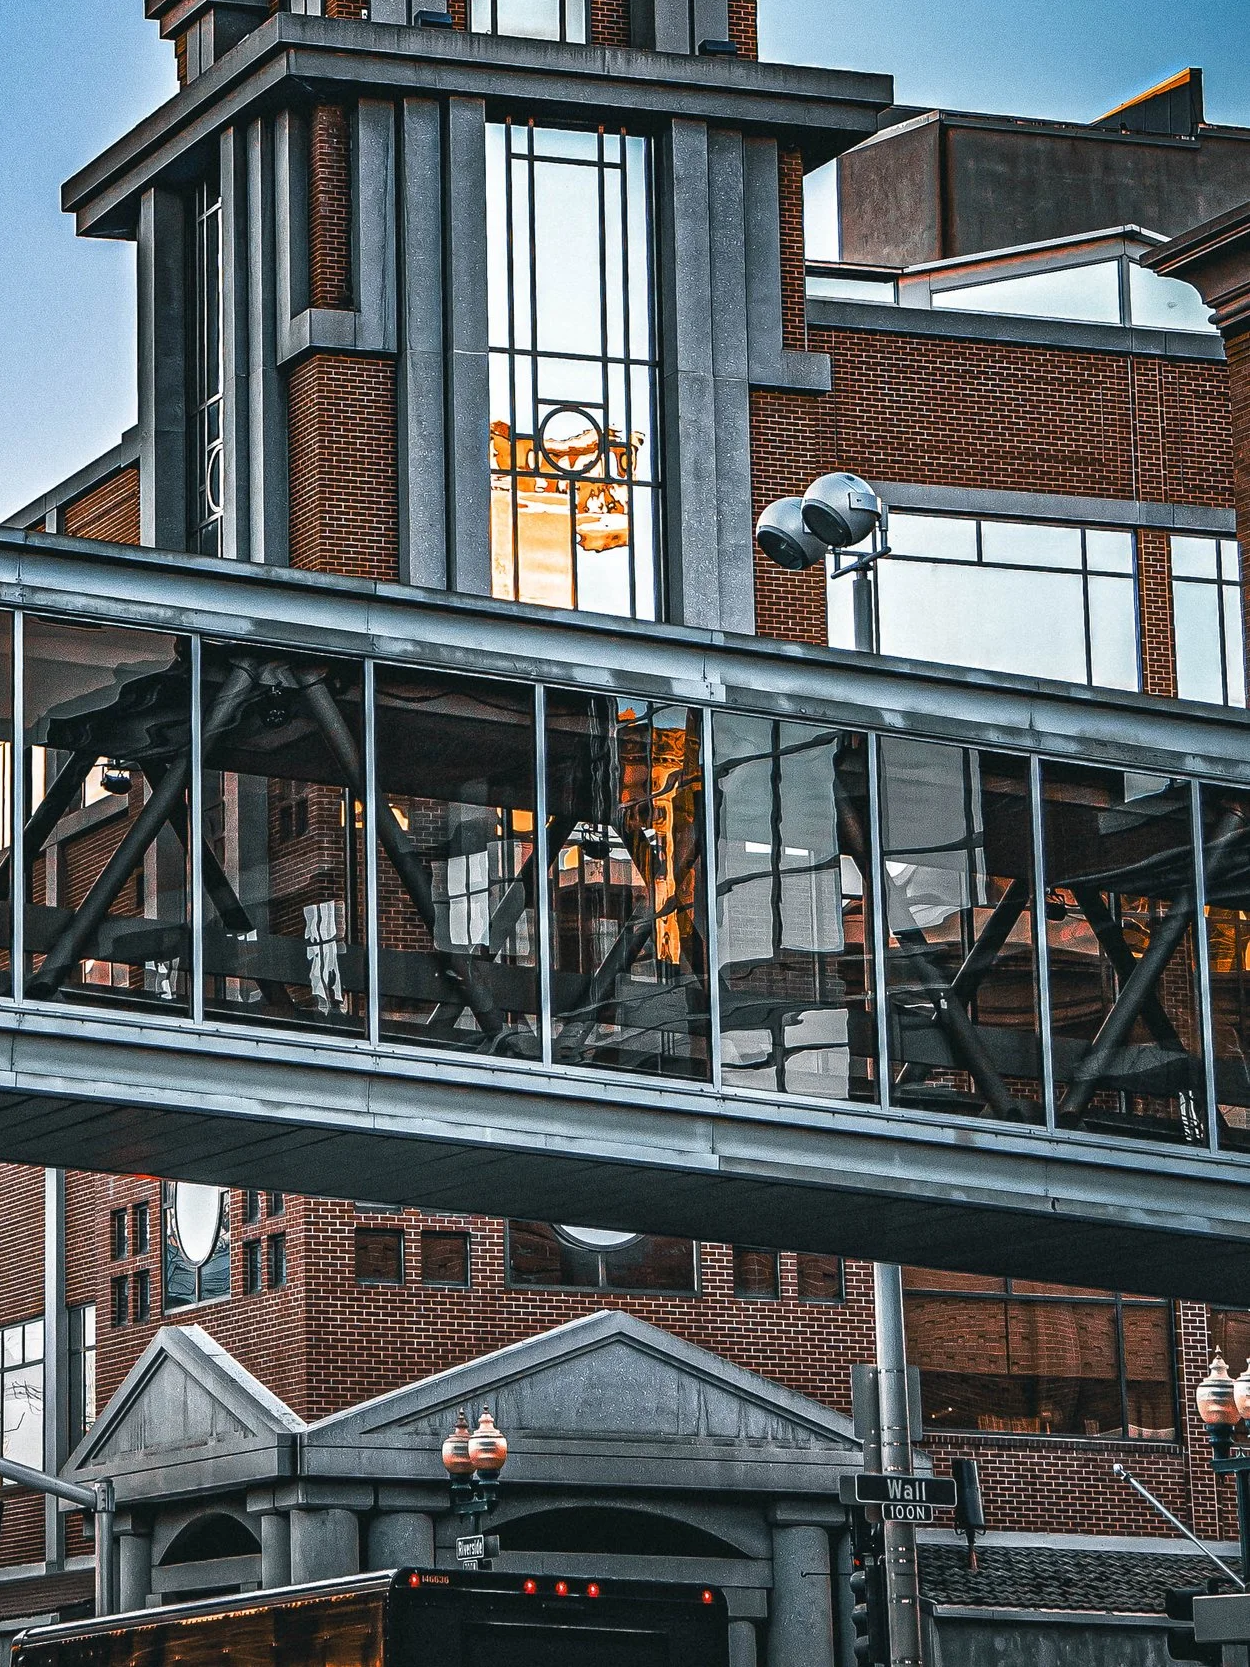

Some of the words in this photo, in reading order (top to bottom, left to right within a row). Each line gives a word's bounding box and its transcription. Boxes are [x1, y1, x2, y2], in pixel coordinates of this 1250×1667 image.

[887, 1479, 926, 1501] Wall
[890, 1505, 925, 1520] 100N
[458, 1540, 482, 1556] Riverside
